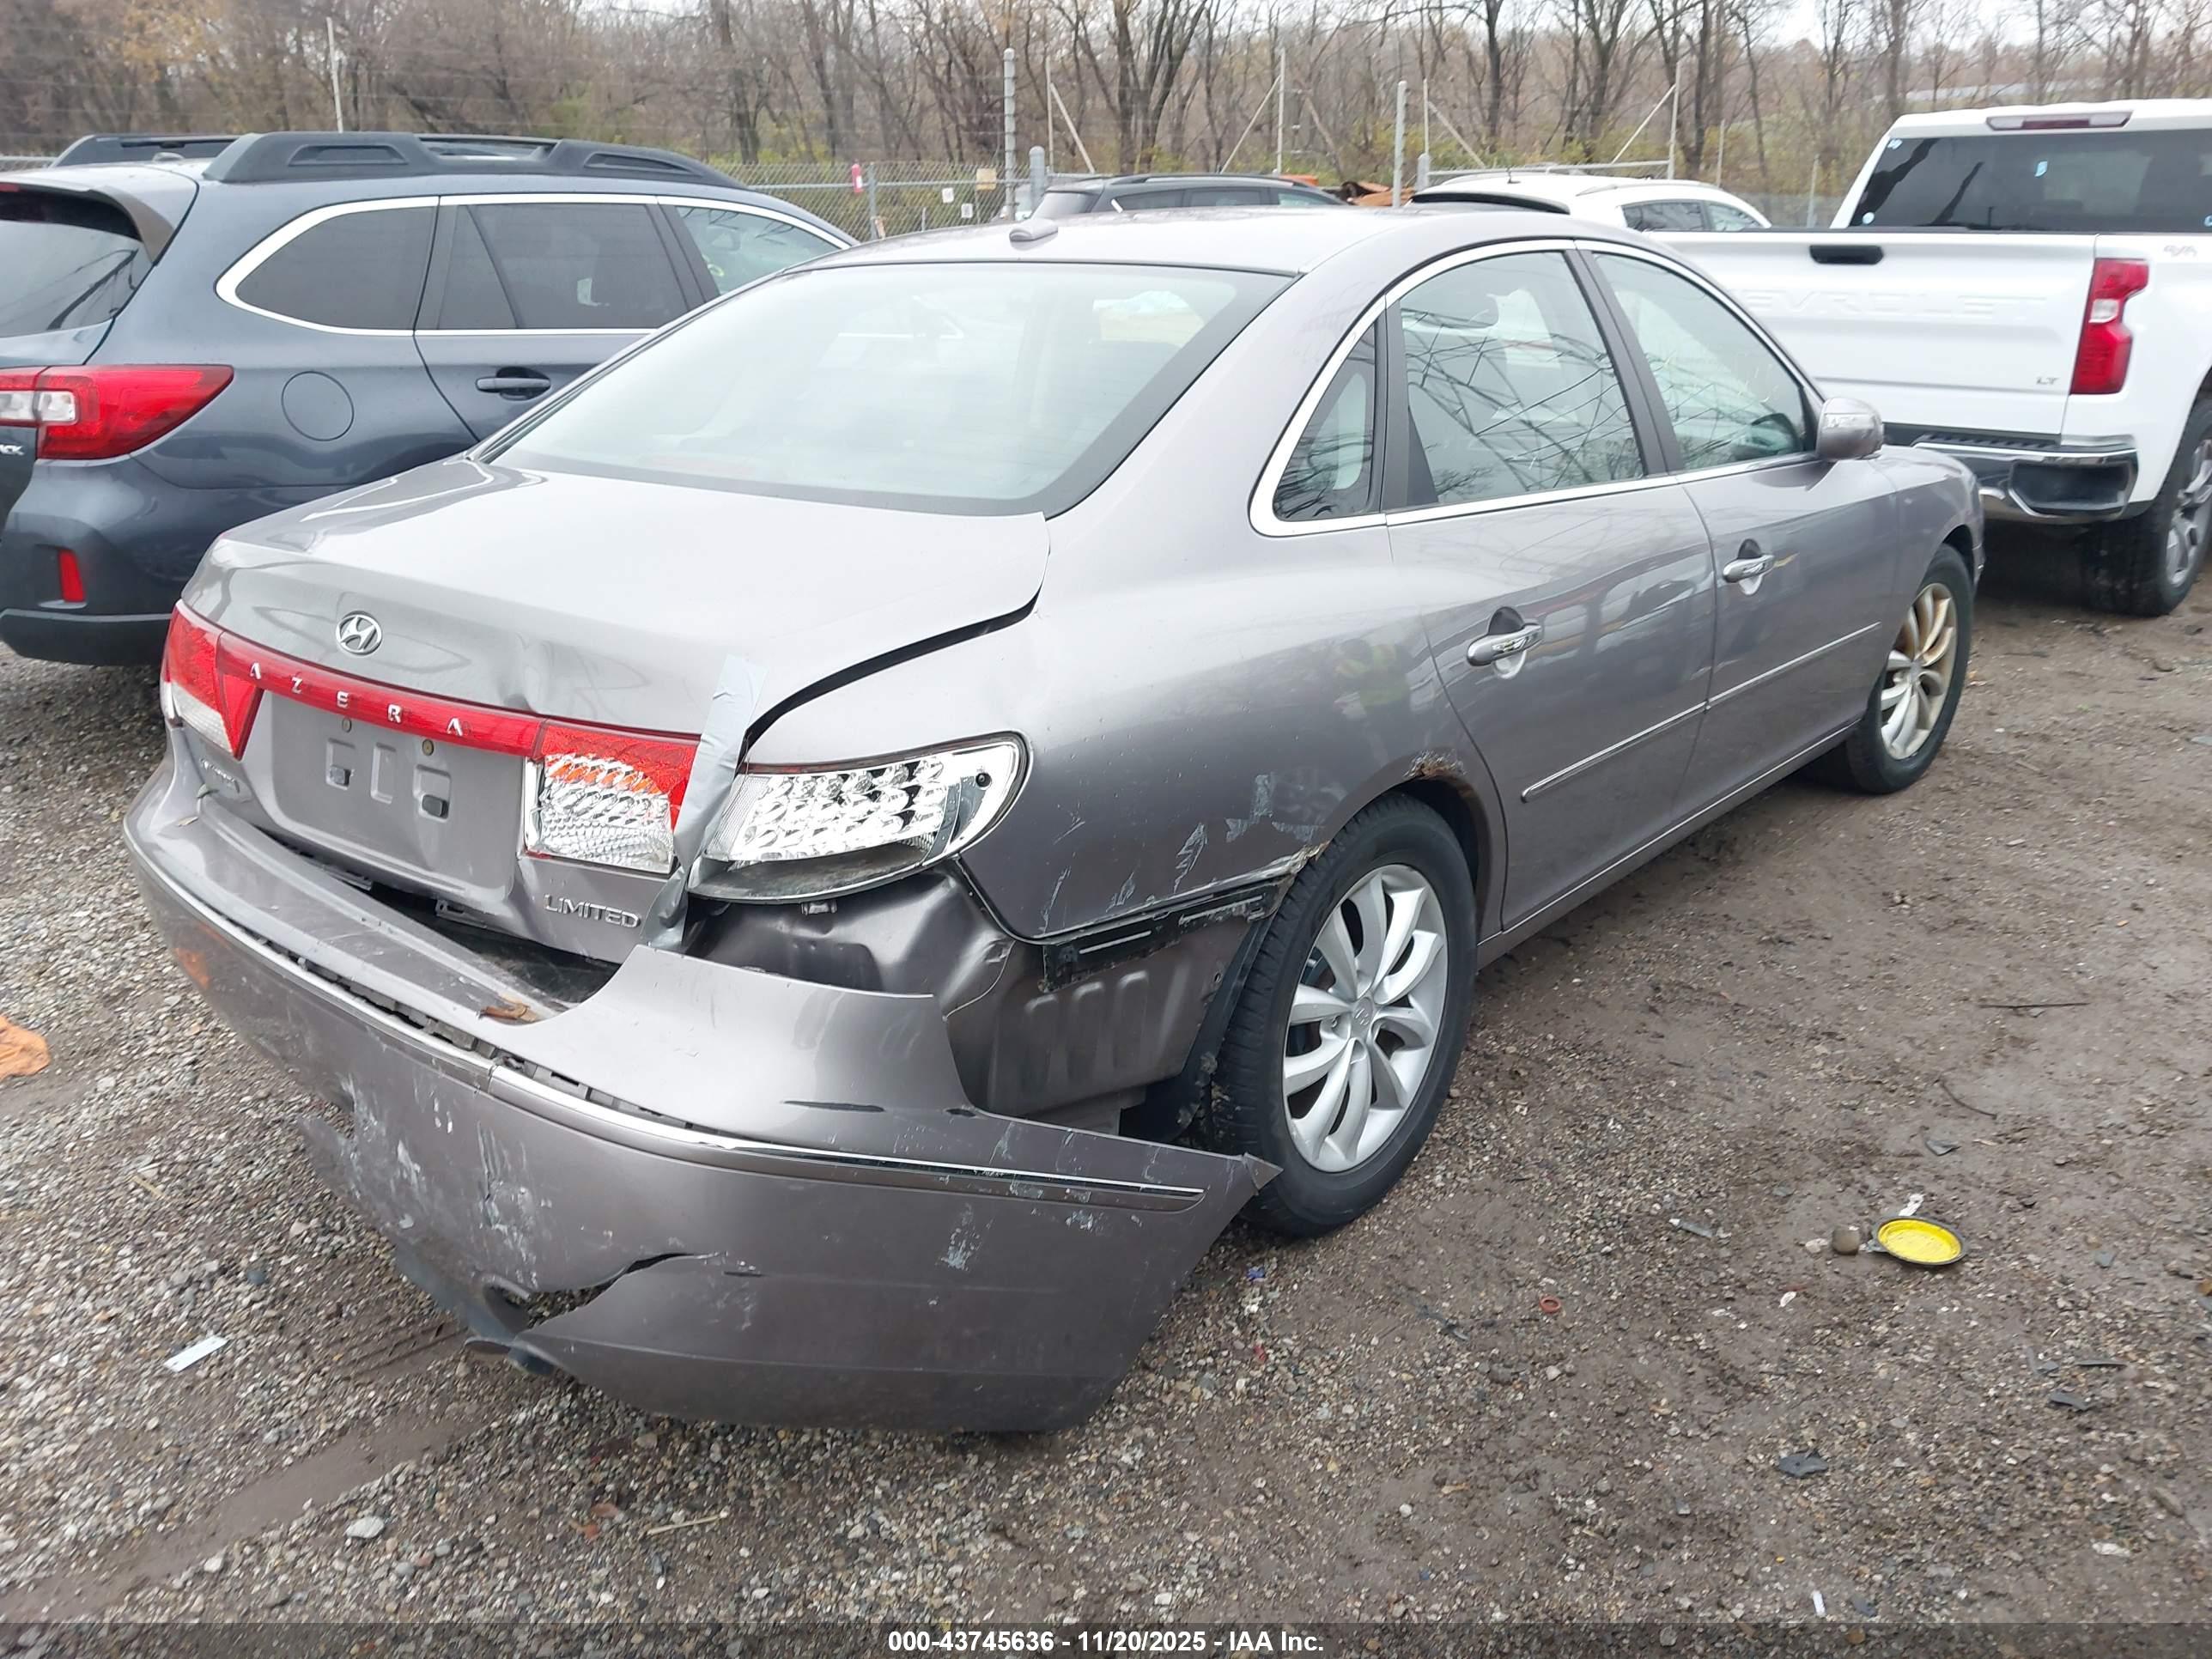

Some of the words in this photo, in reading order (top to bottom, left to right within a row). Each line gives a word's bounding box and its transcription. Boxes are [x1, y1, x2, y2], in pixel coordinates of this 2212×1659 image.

[1731, 289, 2047, 321] EVROLET
[2035, 376, 2059, 386] LT
[250, 662, 464, 737] AZERA
[544, 893, 641, 928] LIMITED
